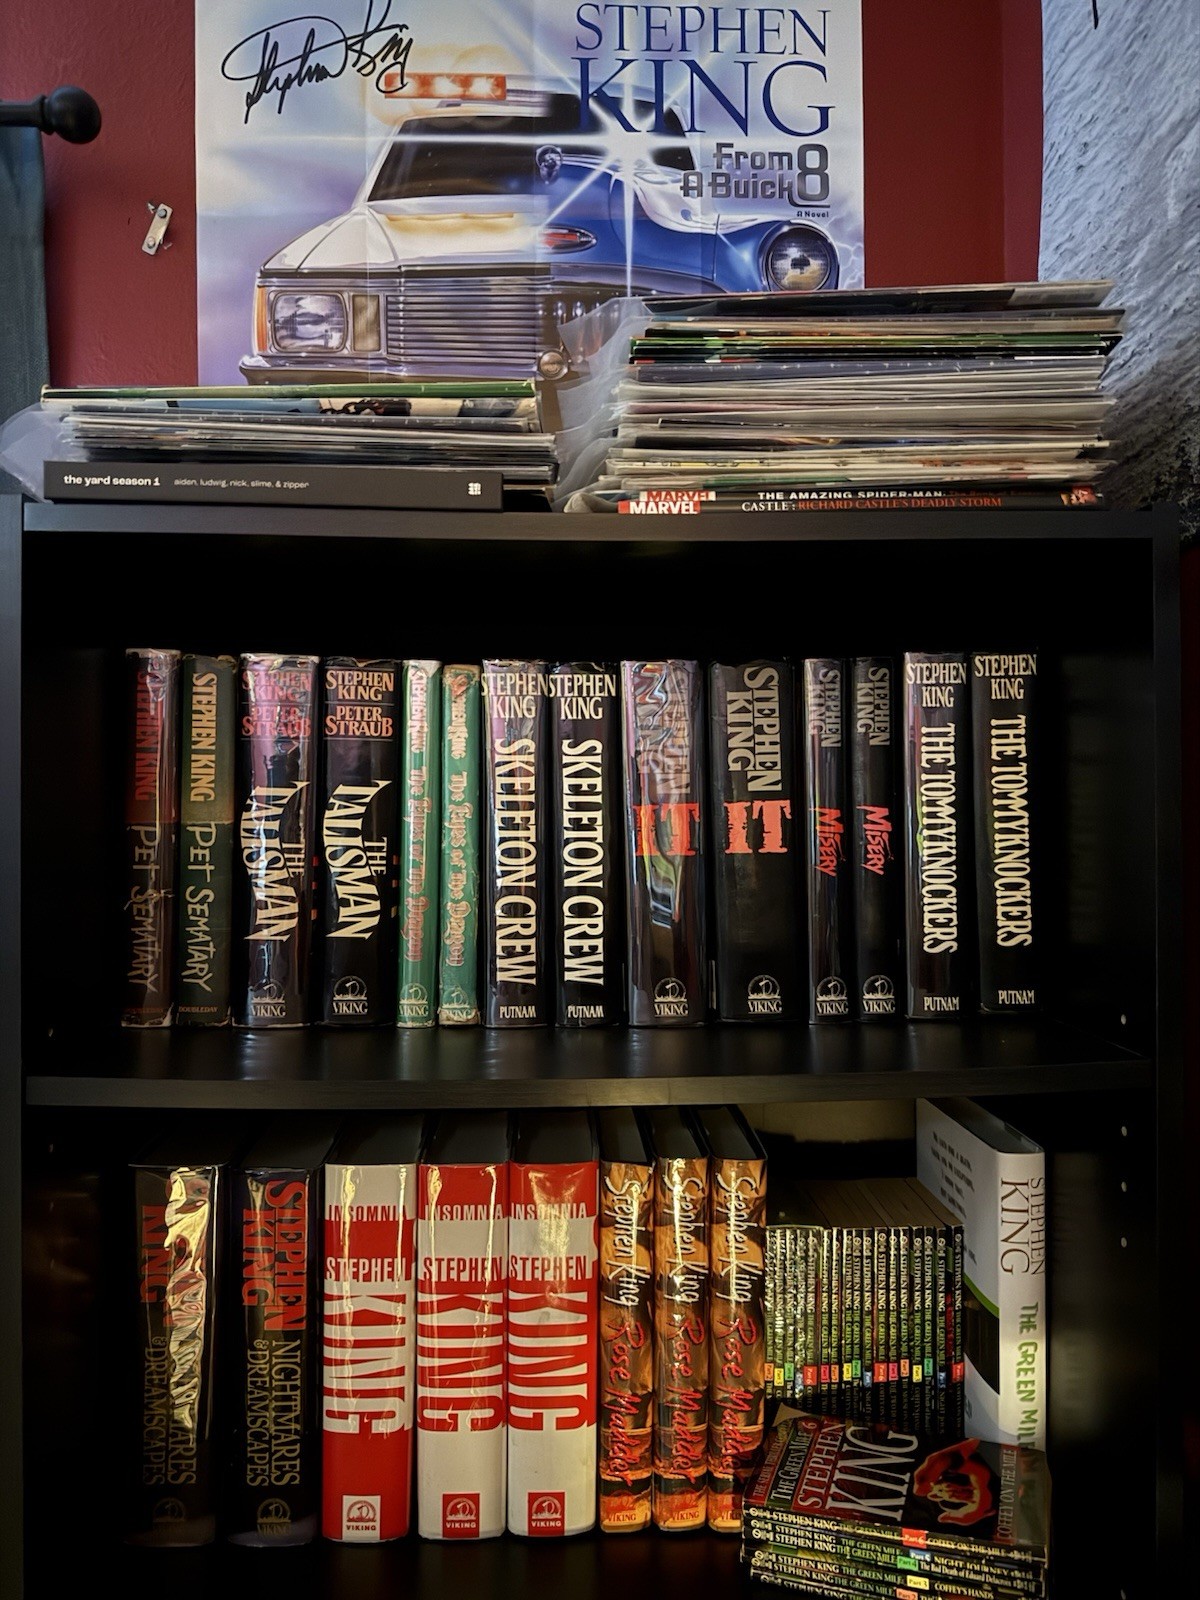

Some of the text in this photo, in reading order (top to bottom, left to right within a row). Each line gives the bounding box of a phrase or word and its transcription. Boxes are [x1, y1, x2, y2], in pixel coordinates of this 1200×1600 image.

[575, 3, 829, 57] STEPHEN
[575, 57, 835, 138] KING
[712, 142, 794, 171] From
[680, 143, 830, 202] A Buick 8
[796, 210, 830, 218] A Novel
[63, 475, 161, 487] the yard season 1
[275, 480, 282, 488] &
[283, 480, 310, 489] zipper
[629, 500, 698, 514] MARVEL
[758, 492, 785, 500] THE
[789, 492, 852, 500] AMAZING
[798, 500, 853, 510] RICHARD
[855, 499, 909, 509] CASTLE'S
[911, 498, 957, 508] DEADLY
[958, 497, 1002, 507] STORM
[906, 662, 967, 685] STEPHEN
[974, 654, 1037, 677] STEPHEN
[325, 670, 394, 692] STEPHEN
[337, 686, 383, 701] KING
[481, 674, 549, 697] STEPHEN
[549, 674, 616, 698] STEPHEN
[991, 678, 1025, 700] KING
[493, 697, 537, 719] KING
[560, 697, 603, 720] KING
[808, 683, 826, 736] KING
[819, 667, 842, 748] STEPHEN
[855, 682, 874, 734] KING
[867, 667, 890, 746] STEPHEN
[921, 687, 954, 708] KING
[253, 705, 300, 721] PETER
[325, 715, 393, 737] STRAUB
[336, 705, 382, 721] PETER
[190, 672, 218, 802] STEPHEN KING
[242, 716, 311, 738] STRAUB
[726, 691, 754, 772] KING
[743, 666, 782, 792] STEPHEN
[633, 803, 700, 856] IT
[724, 800, 792, 854] IT
[920, 723, 958, 954] THE TOMMYKNOCKERS
[990, 714, 1033, 947] THE TOMMYKNOCKERS
[240, 780, 311, 942] TALISMAN
[282, 842, 306, 878] THE
[322, 780, 392, 940] TALISMAN
[364, 837, 388, 877] THE
[494, 738, 538, 986] SKELETON CREW
[561, 738, 604, 986] SKELETON CREW
[181, 885, 217, 993] SEMATARY
[332, 1001, 369, 1014] VIKING
[654, 1002, 689, 1015] VIKING
[748, 1001, 782, 1013] VIKING
[816, 1003, 848, 1014] VIKING
[863, 1001, 895, 1013] VIKING
[923, 996, 959, 1011] PUTNAM
[998, 989, 1035, 1004] PUTNAM
[251, 1004, 286, 1017] VIKING
[399, 1005, 429, 1017] VIKING
[499, 1005, 537, 1019] PUTNAM
[567, 1005, 604, 1018] PUTNAM
[328, 1205, 408, 1222] INSOMNIA
[424, 1204, 503, 1221] INSOMNIA
[511, 1203, 588, 1220] INSOMNIA
[1000, 1178, 1030, 1275] KING
[1030, 1177, 1046, 1275] STEPHEN
[604, 1176, 650, 1306] Stephen King
[241, 1208, 275, 1306] KING
[263, 1179, 306, 1331] STEPHEN
[510, 1256, 587, 1281] STEPHEN
[326, 1257, 407, 1282] STEPHEN
[423, 1257, 503, 1281] STEPHEN
[924, 1256, 933, 1289] STEPHEN
[954, 1255, 962, 1289] STEPHEN
[924, 1290, 933, 1308] KING
[954, 1290, 962, 1310] KING
[1019, 1301, 1039, 1335] THE
[323, 1281, 407, 1434] KING
[417, 1281, 503, 1432] KING
[508, 1280, 589, 1431] KING
[1016, 1341, 1039, 1402] GREEN
[246, 1338, 270, 1488] & DREAMSCAPES
[270, 1339, 301, 1486] NIGHTMARES
[603, 1321, 645, 1487] Rose Madder
[665, 1317, 705, 1485] Rose Madder
[778, 1449, 806, 1480] GREEN
[797, 1420, 846, 1509] STEPHEN
[826, 1425, 919, 1521] KING
[770, 1479, 796, 1500] THE
[608, 1512, 637, 1522] VIKING
[672, 1510, 700, 1521] VIKING
[778, 1554, 817, 1570] STEPHEN
[817, 1563, 840, 1575] KING
[841, 1565, 857, 1577] THE
[857, 1568, 884, 1582] GREEN
[969, 1588, 994, 1600] HANDS
